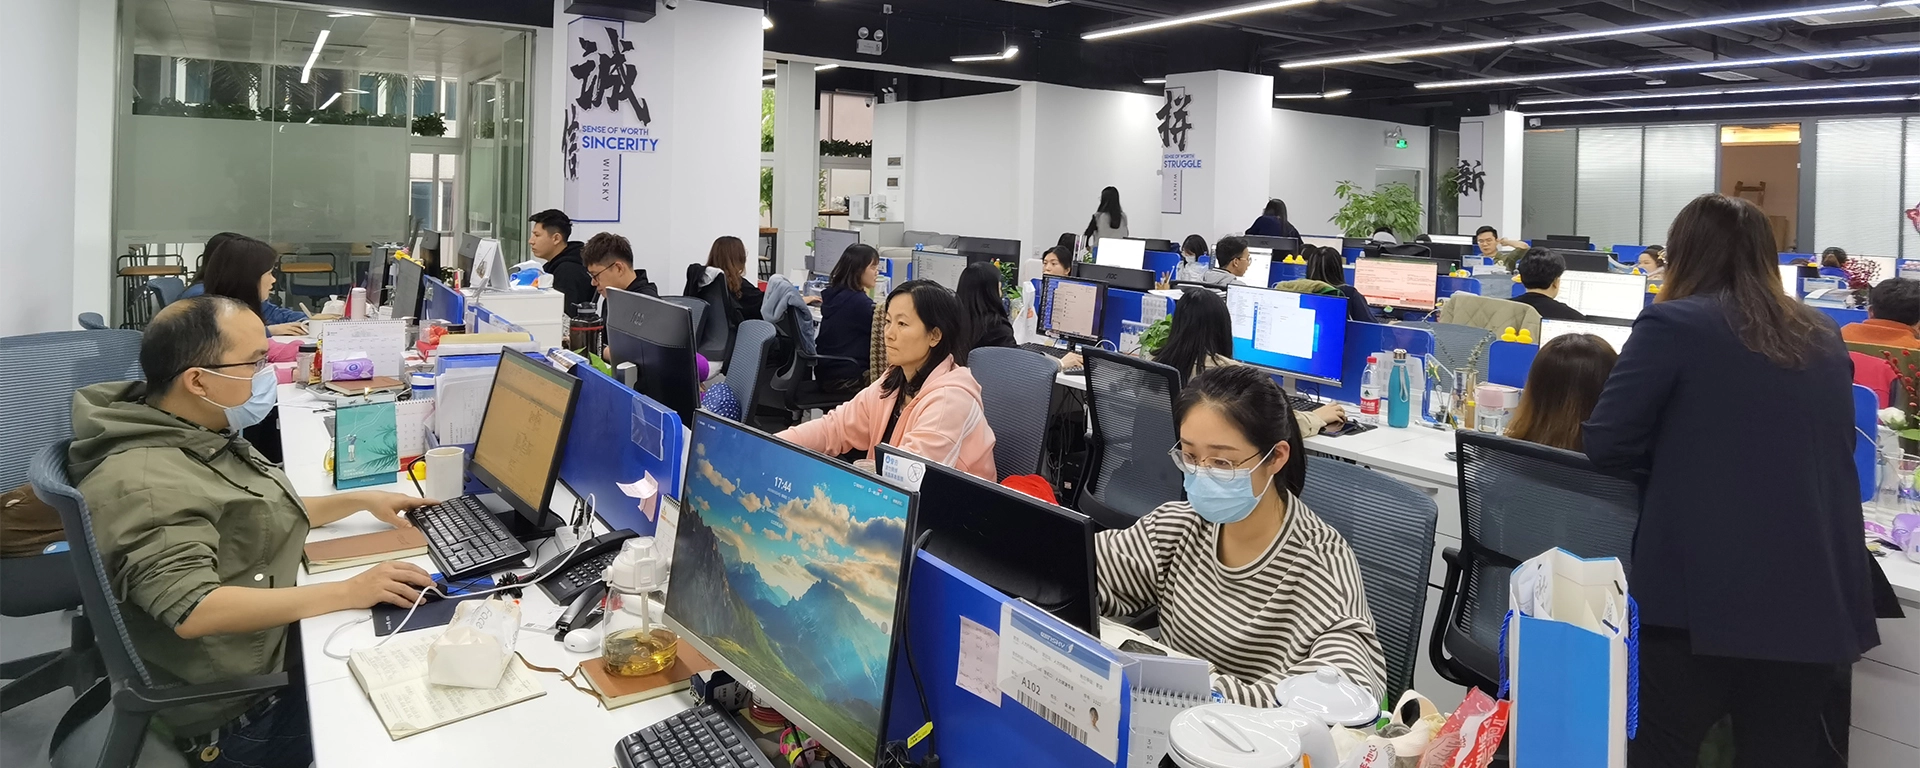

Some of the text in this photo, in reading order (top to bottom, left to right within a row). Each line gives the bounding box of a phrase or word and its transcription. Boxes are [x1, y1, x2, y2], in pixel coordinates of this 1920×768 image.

[1156, 90, 1192, 152] 拼
[582, 125, 649, 136] SENSE OF WORTH
[582, 135, 659, 152] SINCERITY
[1163, 160, 1202, 168] STRUGGLE
[602, 158, 610, 202] WINSKY
[1456, 160, 1486, 201] 新
[774, 476, 792, 493] 17:44
[1021, 676, 1041, 696] A102
